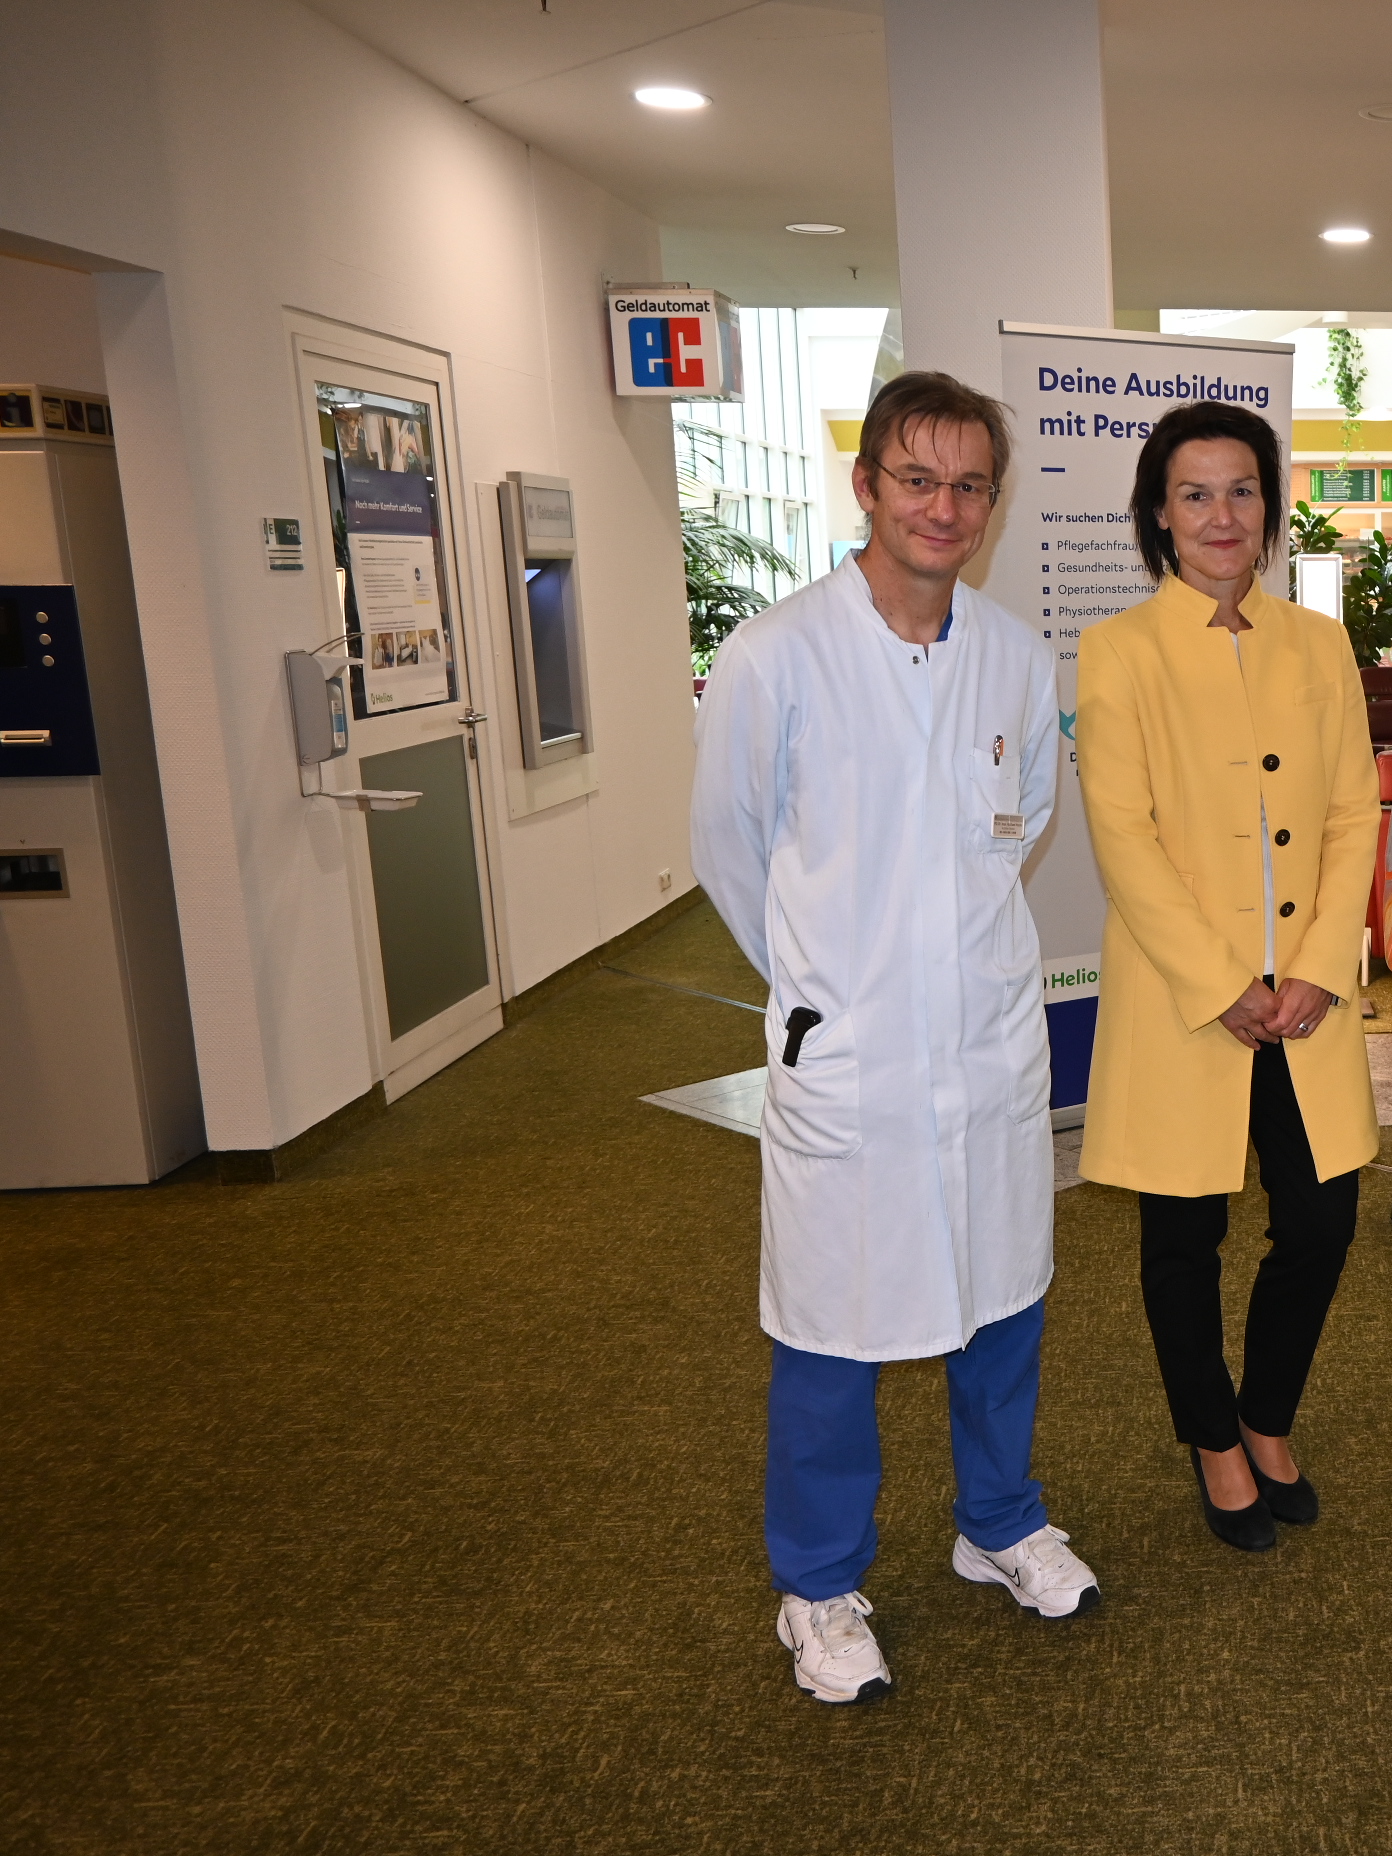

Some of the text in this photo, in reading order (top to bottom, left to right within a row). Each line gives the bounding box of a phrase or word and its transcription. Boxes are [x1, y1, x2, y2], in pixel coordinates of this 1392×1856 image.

[615, 299, 711, 313] Geldautomat
[1038, 366, 1269, 409] Deine Ausbildung
[1039, 411, 1159, 439] mit Pers
[355, 500, 422, 514] Noch mehr Komfort und Service
[1041, 512, 1131, 523] Wir suchen Dich
[1057, 562, 1128, 573] Gesundheits-
[1051, 968, 1100, 989] Helio
